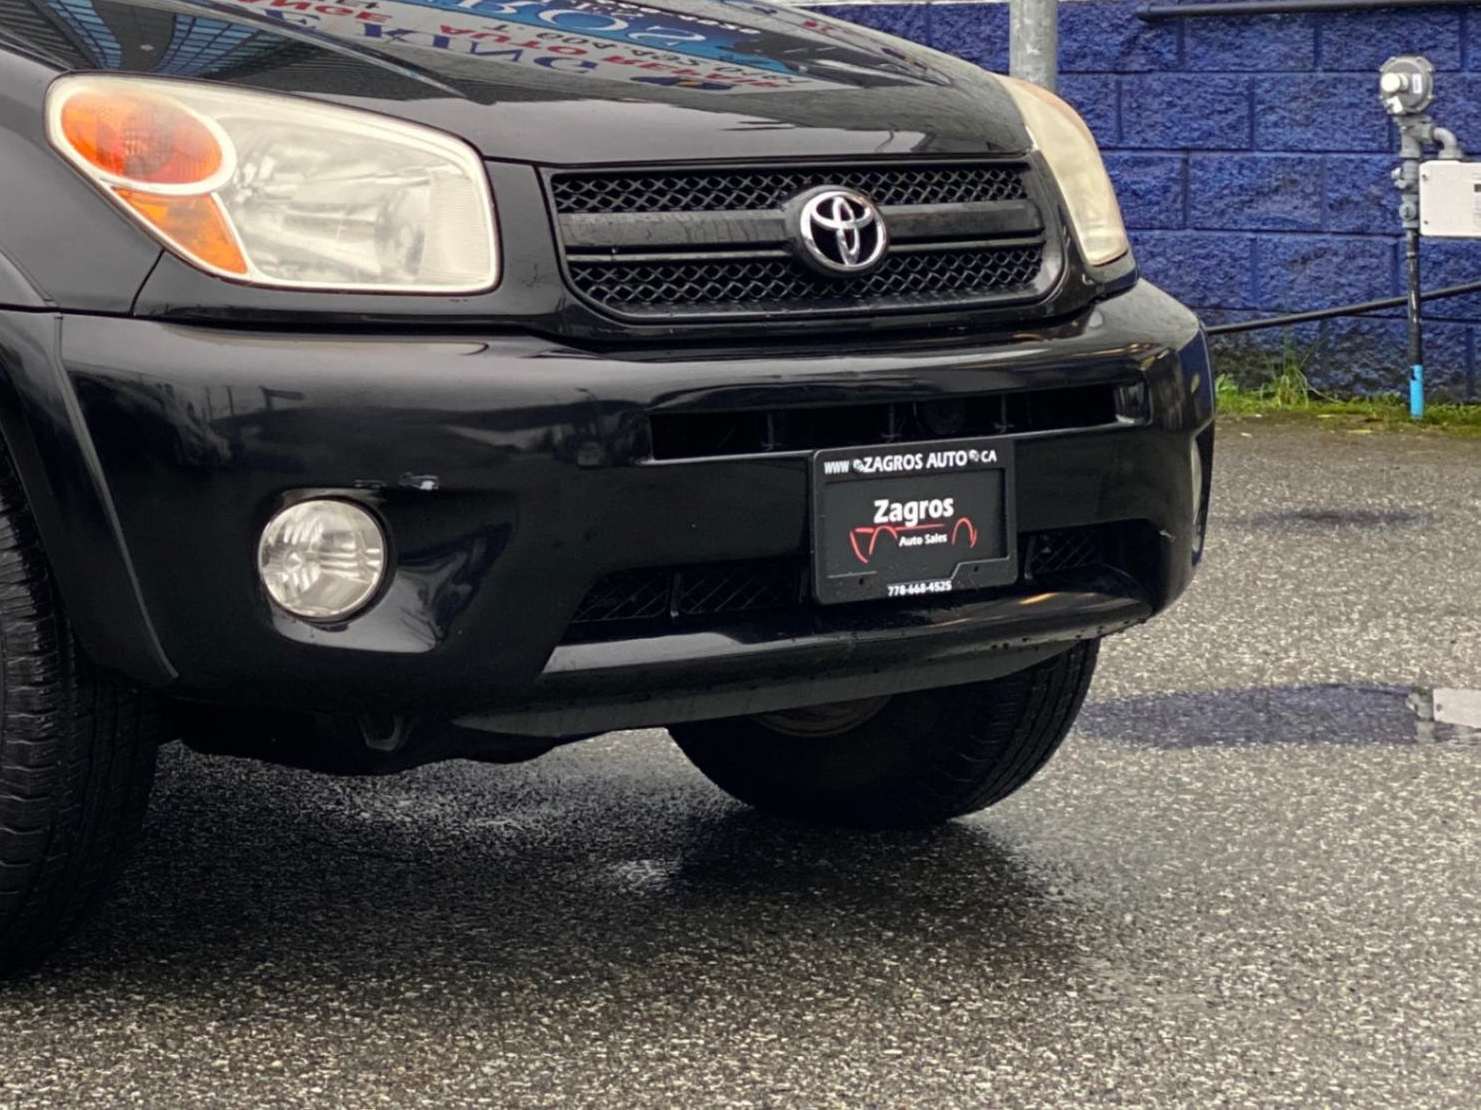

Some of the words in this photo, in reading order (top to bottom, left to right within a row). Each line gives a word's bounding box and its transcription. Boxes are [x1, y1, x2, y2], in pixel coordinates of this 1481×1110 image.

[863, 453, 923, 473] ZAGROS
[926, 450, 968, 469] AUTO
[980, 450, 997, 463] CA
[873, 497, 955, 527] Zagros
[899, 535, 923, 547] Auto
[925, 533, 948, 545] Sales
